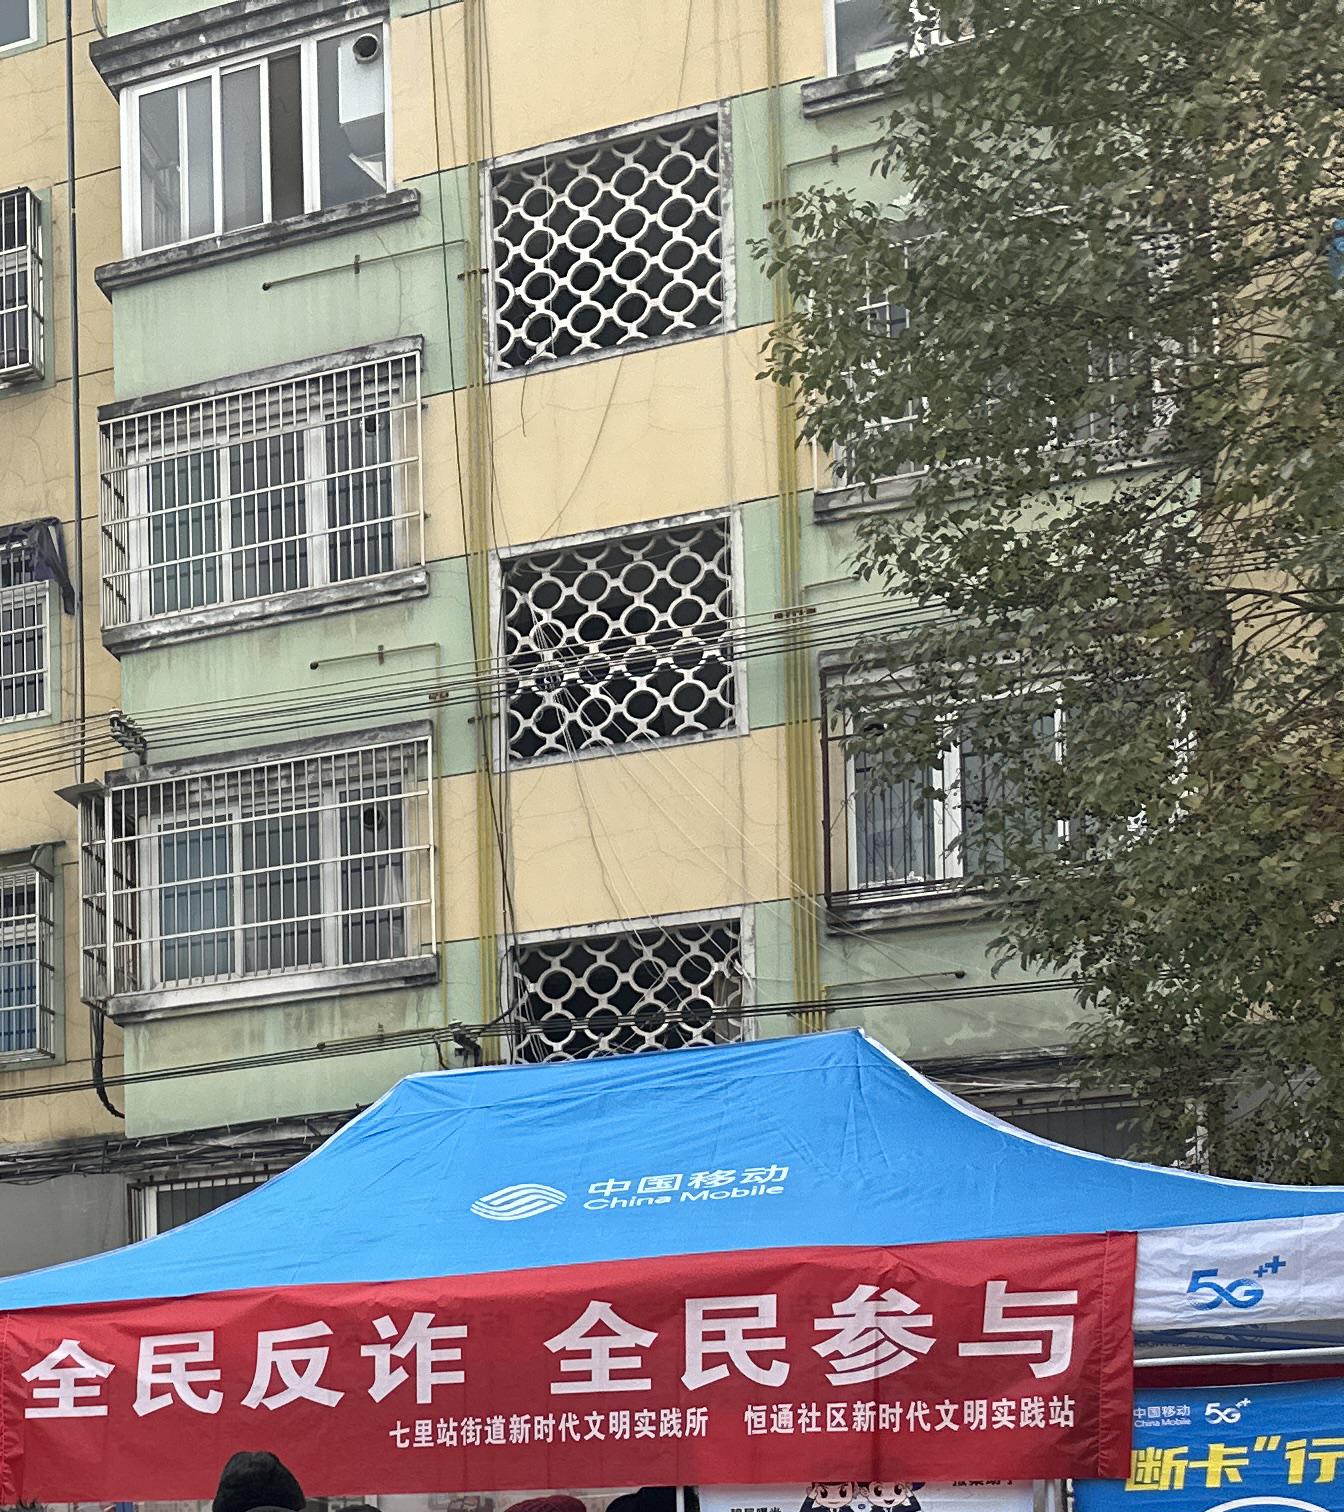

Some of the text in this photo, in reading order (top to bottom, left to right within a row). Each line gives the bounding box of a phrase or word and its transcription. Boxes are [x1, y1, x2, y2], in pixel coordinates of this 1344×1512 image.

[588, 1164, 789, 1198] 中国移动
[583, 1184, 785, 1211] China Mobile
[21, 1280, 1079, 1420] 全民反诈 全民参与
[389, 1395, 1077, 1450] 七里站街道新时代文明实践所 恒通社区新时代文明实践站
[1133, 1404, 1191, 1419] 中国移动
[1134, 1417, 1192, 1428] China Mobile
